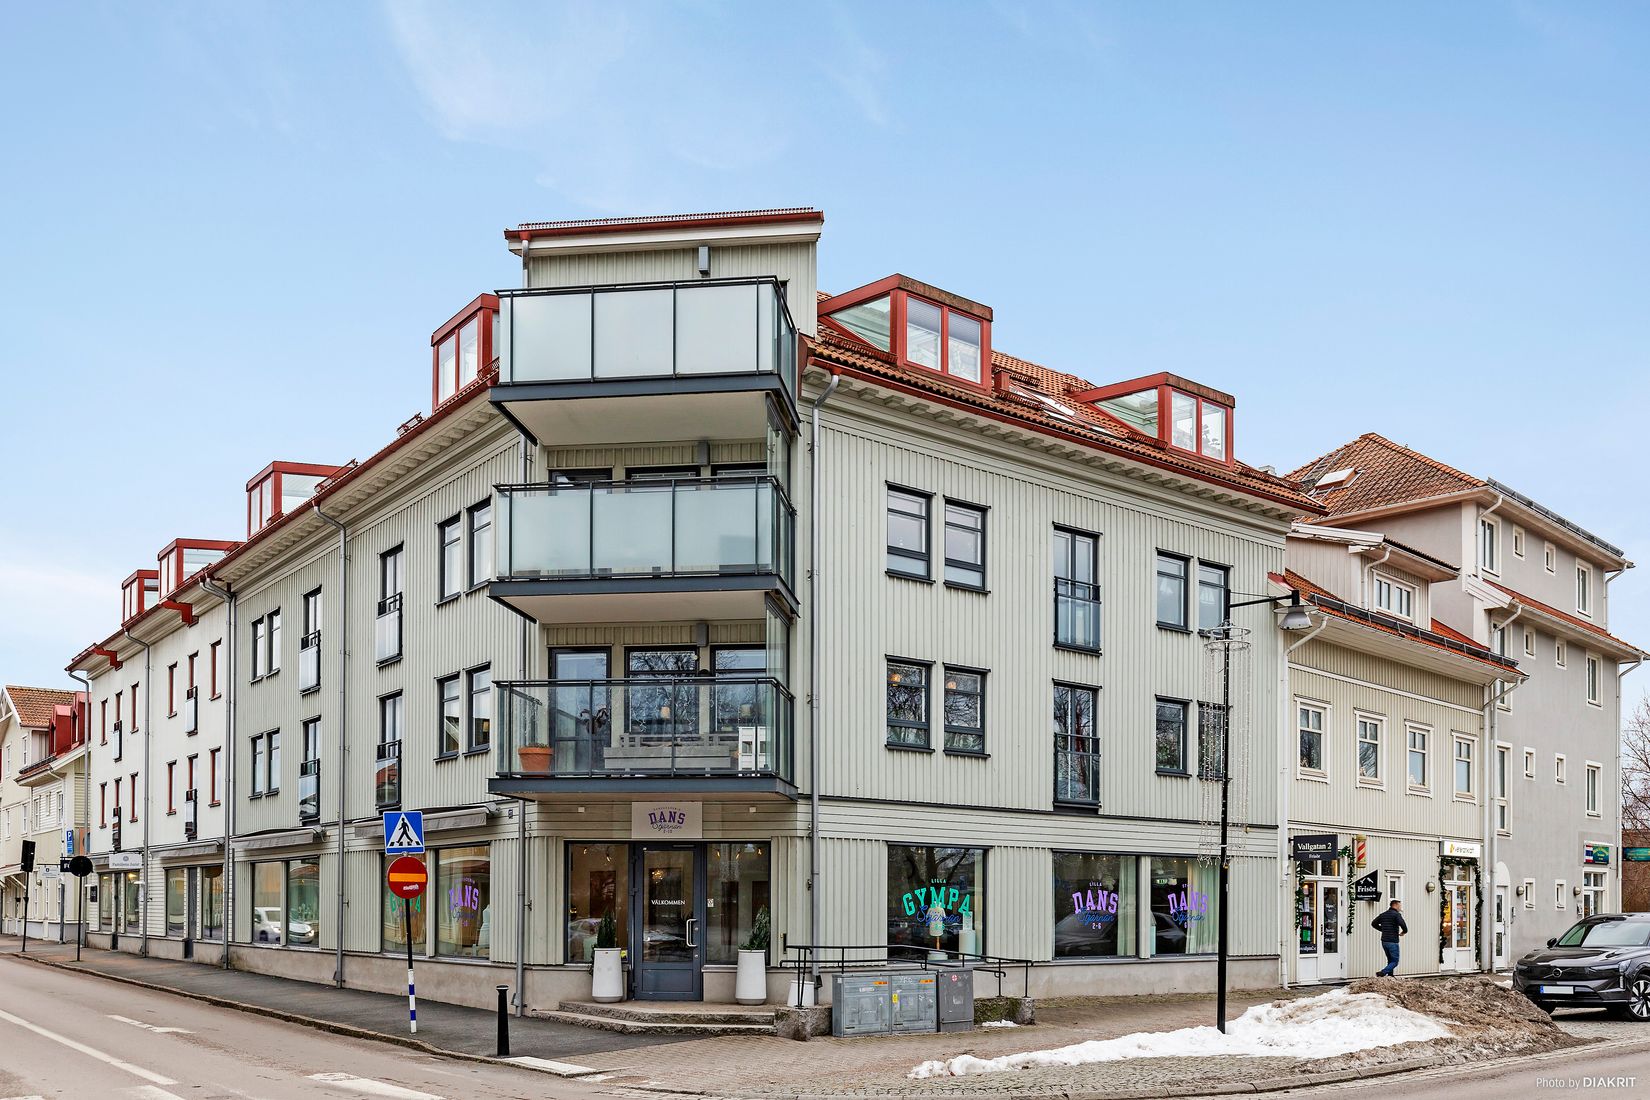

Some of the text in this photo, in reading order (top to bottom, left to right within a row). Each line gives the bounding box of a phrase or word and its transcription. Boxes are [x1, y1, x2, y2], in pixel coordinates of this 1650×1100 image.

[648, 810, 686, 825] DANS
[1297, 842, 1332, 851] Vallgatan 2
[448, 884, 480, 911] DANS
[902, 886, 971, 917] GYMPA
[1071, 889, 1119, 914] DANS
[1167, 890, 1209, 914] DANS
